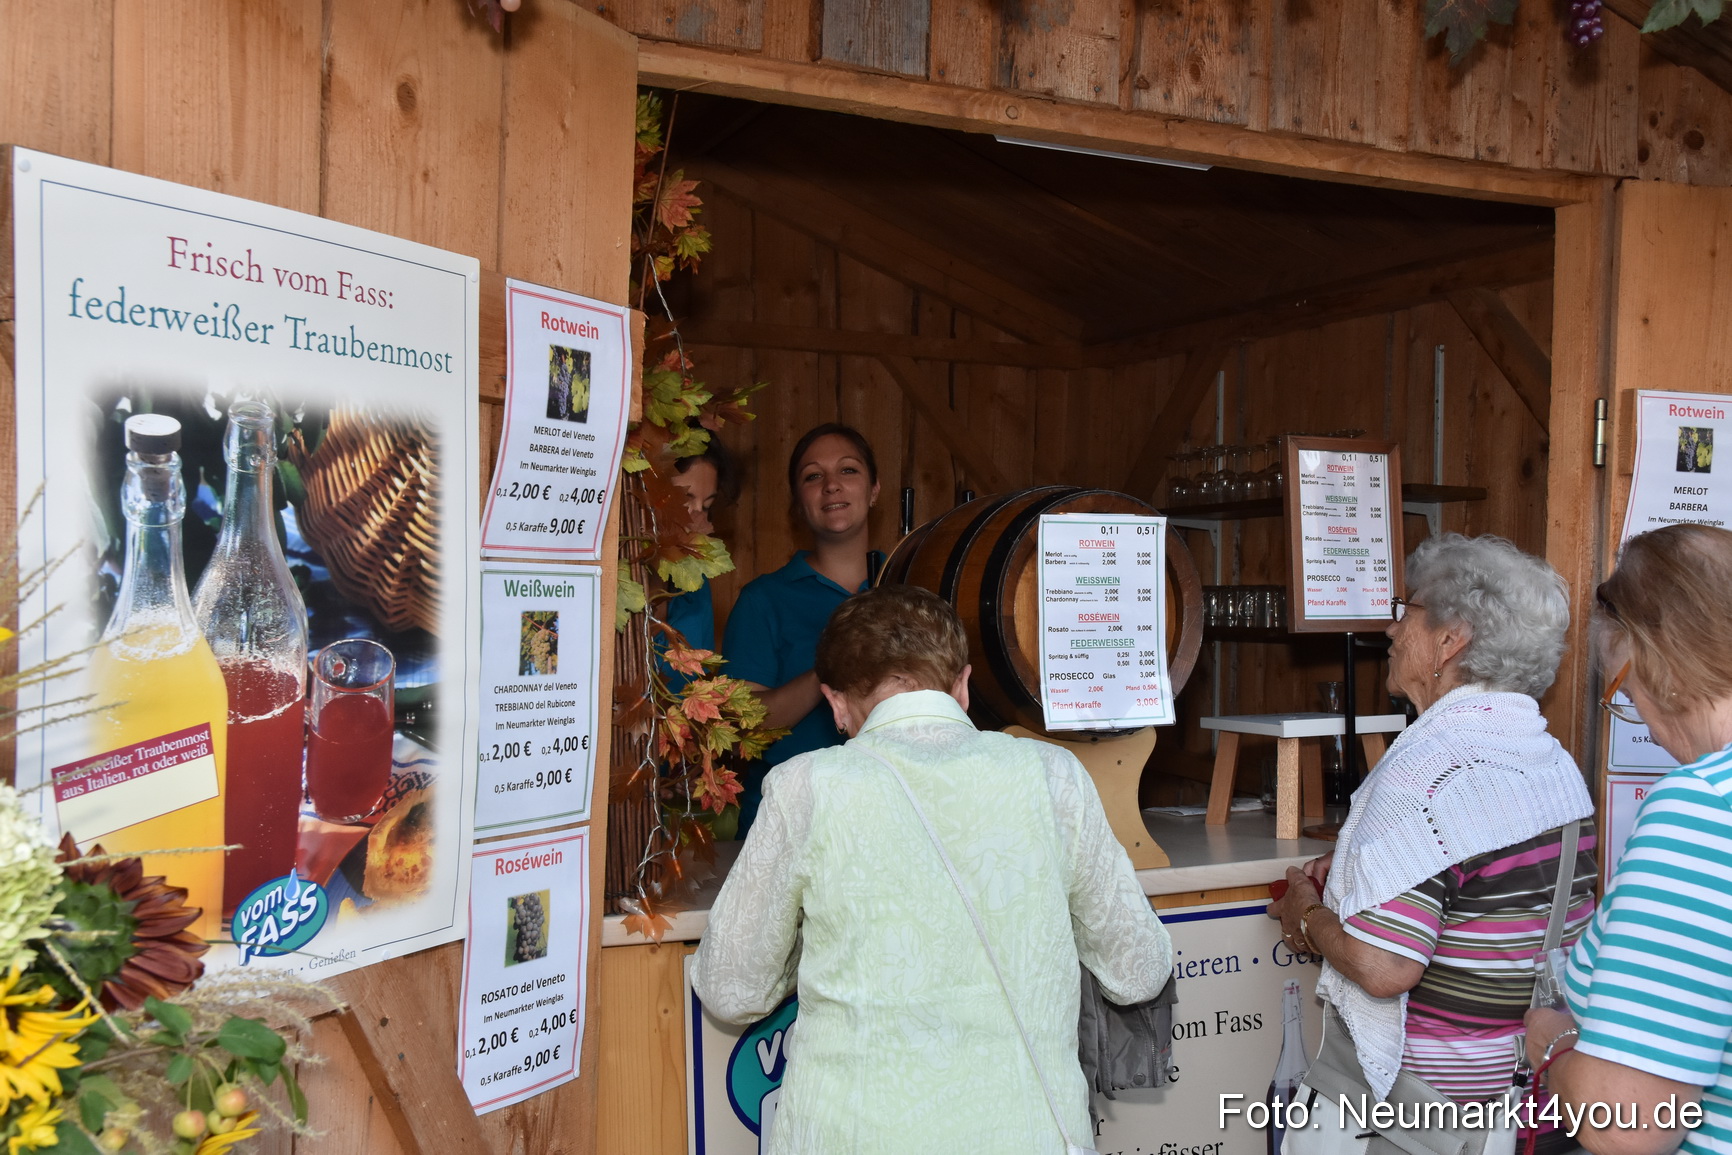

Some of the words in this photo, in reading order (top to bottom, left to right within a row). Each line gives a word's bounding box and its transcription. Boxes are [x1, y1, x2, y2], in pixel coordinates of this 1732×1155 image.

[166, 236, 264, 284] Frisch
[273, 267, 329, 295] vom
[337, 271, 395, 309] Fass:
[68, 278, 274, 345] federweißer
[284, 314, 453, 373] Traubenmost
[541, 311, 599, 340] Rotwein
[1669, 404, 1724, 419] Rotwein
[534, 426, 561, 437] MERLOT
[562, 429, 572, 439] del
[573, 431, 595, 441] Veneto
[530, 444, 560, 454] BARBERA
[561, 447, 571, 456] del
[572, 448, 594, 459] Veneto
[1342, 454, 1352, 462] 0,1
[520, 461, 529, 469] Im
[530, 462, 568, 474] Neumarkter
[570, 467, 597, 477] Weinglas
[1327, 464, 1354, 472] ROTWEIN
[496, 487, 507, 497] 0,1
[509, 482, 540, 501] 2,00
[542, 485, 551, 501] €
[559, 493, 570, 503] 0,2
[571, 487, 596, 504] 4,00
[597, 489, 605, 504] €
[1325, 495, 1358, 503] WEISSWEIN
[1674, 486, 1708, 495] MERLOT
[1669, 502, 1708, 511] BARBERA
[506, 522, 517, 531] 0,5
[519, 522, 548, 532] Karaffe
[549, 518, 575, 536] 9,00
[577, 520, 585, 534] €
[1101, 526, 1114, 535] 0,1
[1137, 527, 1150, 536] 0,5
[1079, 540, 1115, 548] ROTWEIN
[1323, 547, 1370, 556] FEDERWEISSER
[504, 579, 575, 598] Weißwein
[1076, 577, 1120, 585] WEISSWEIN
[1078, 612, 1120, 622] ROSÉWEIN
[1070, 639, 1135, 649] FEDERWEISSER
[1050, 672, 1094, 680] PROSECCO
[494, 684, 542, 694] CHARDONNAY
[544, 683, 554, 692] del
[555, 682, 577, 691] Veneto
[495, 702, 534, 712] TREBBIANO
[535, 701, 546, 710] del
[547, 699, 575, 708] Rubicone
[1052, 702, 1073, 710] Pfand
[1075, 701, 1102, 709] Karaffe
[1136, 698, 1159, 707] 3,00€
[496, 722, 504, 730] Im
[506, 719, 545, 729] Neumarkter
[547, 716, 575, 728] Weinglas
[135, 730, 209, 761] Traubenmost
[480, 753, 490, 762] 0,1
[492, 742, 520, 762] 2,00
[523, 741, 532, 756] €
[542, 746, 551, 755] 0,2
[553, 736, 579, 754] 4,00
[581, 735, 588, 750] €
[62, 785, 84, 799] aus
[133, 764, 149, 777] rot
[152, 755, 178, 770] oder
[181, 743, 208, 761] weiß
[495, 784, 505, 794] 0,5
[506, 780, 534, 792] Karaffe
[536, 769, 562, 789] 9,00
[565, 768, 572, 783] €
[495, 849, 563, 876] Roséwein
[239, 885, 282, 928] vom
[239, 882, 318, 966] FASS
[309, 949, 356, 970] Genießen
[1172, 951, 1241, 980] ieren
[481, 986, 518, 1005] ROSATO
[521, 981, 534, 992] del
[536, 973, 566, 989] Veneto
[484, 1015, 493, 1023] Im
[494, 1002, 534, 1020] Neumarkter
[536, 993, 564, 1009] Weinglas
[1214, 1011, 1263, 1035] Fass
[465, 1049, 476, 1059] 0,1
[478, 1030, 507, 1056] 2,00
[510, 1027, 519, 1043] €
[529, 1029, 539, 1038] 0,2
[540, 1012, 566, 1036] 4,00
[569, 1009, 577, 1024] €
[480, 1075, 491, 1086] 0,5
[493, 1065, 522, 1082] Karaffe
[524, 1048, 550, 1073] 9,00
[553, 1045, 561, 1060] €
